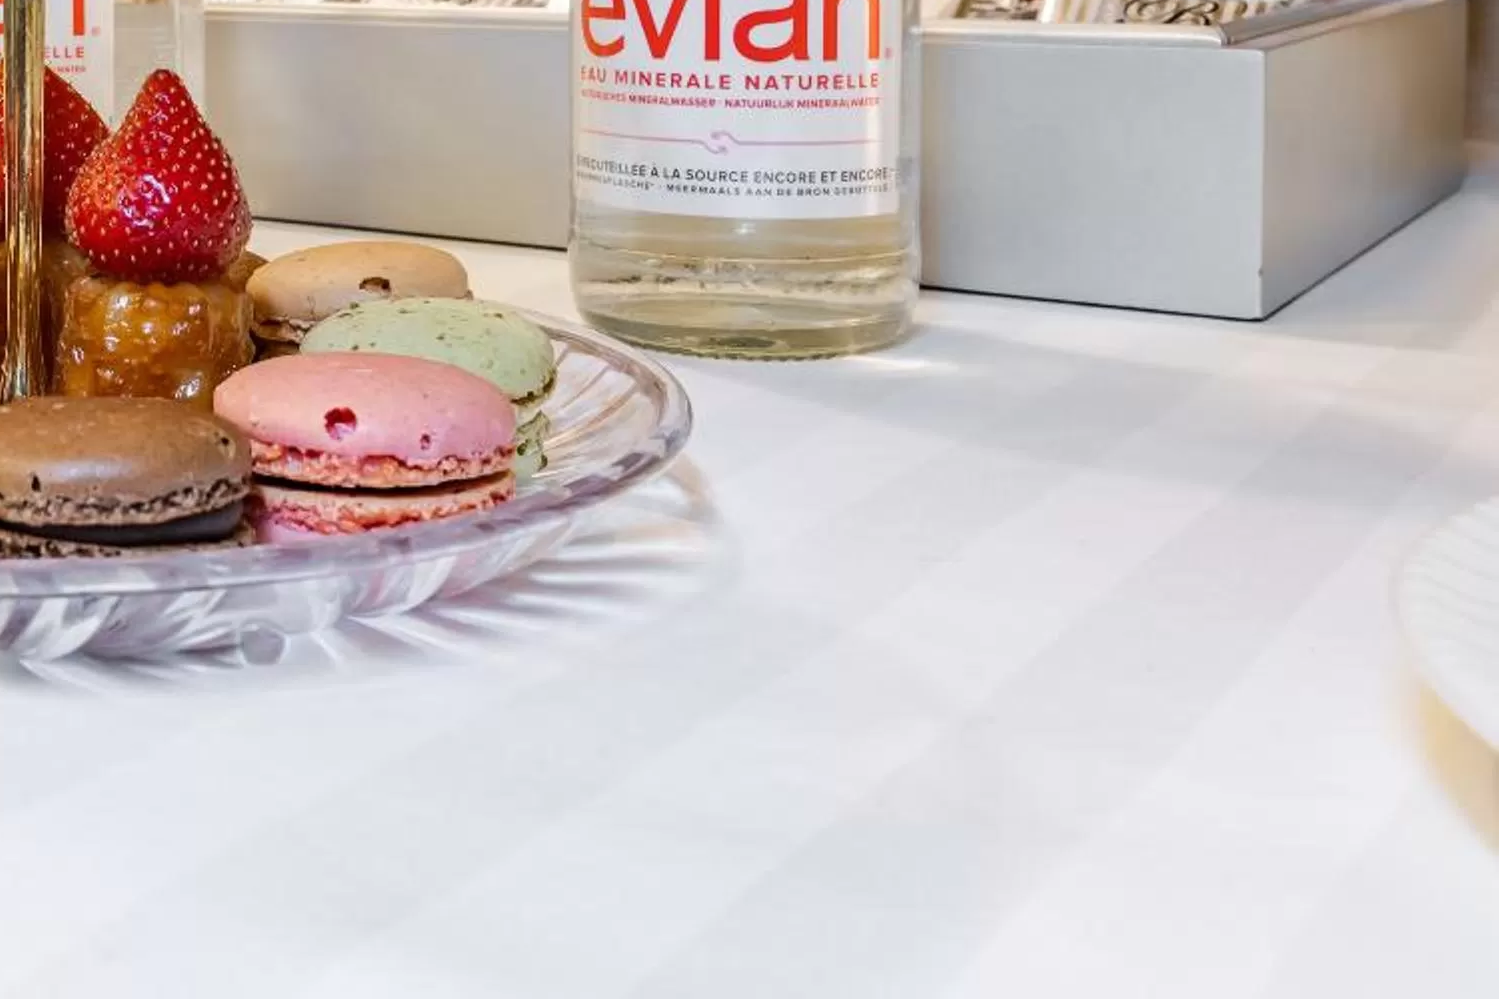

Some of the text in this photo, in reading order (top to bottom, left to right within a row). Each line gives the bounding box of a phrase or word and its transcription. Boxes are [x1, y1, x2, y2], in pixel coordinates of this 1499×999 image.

[580, 66, 880, 91] EAU MINERALE NATURELLE
[663, 168, 681, 180] LA
[685, 168, 749, 184] SOURCE
[753, 170, 817, 185] ENCORE
[820, 170, 838, 184] ET
